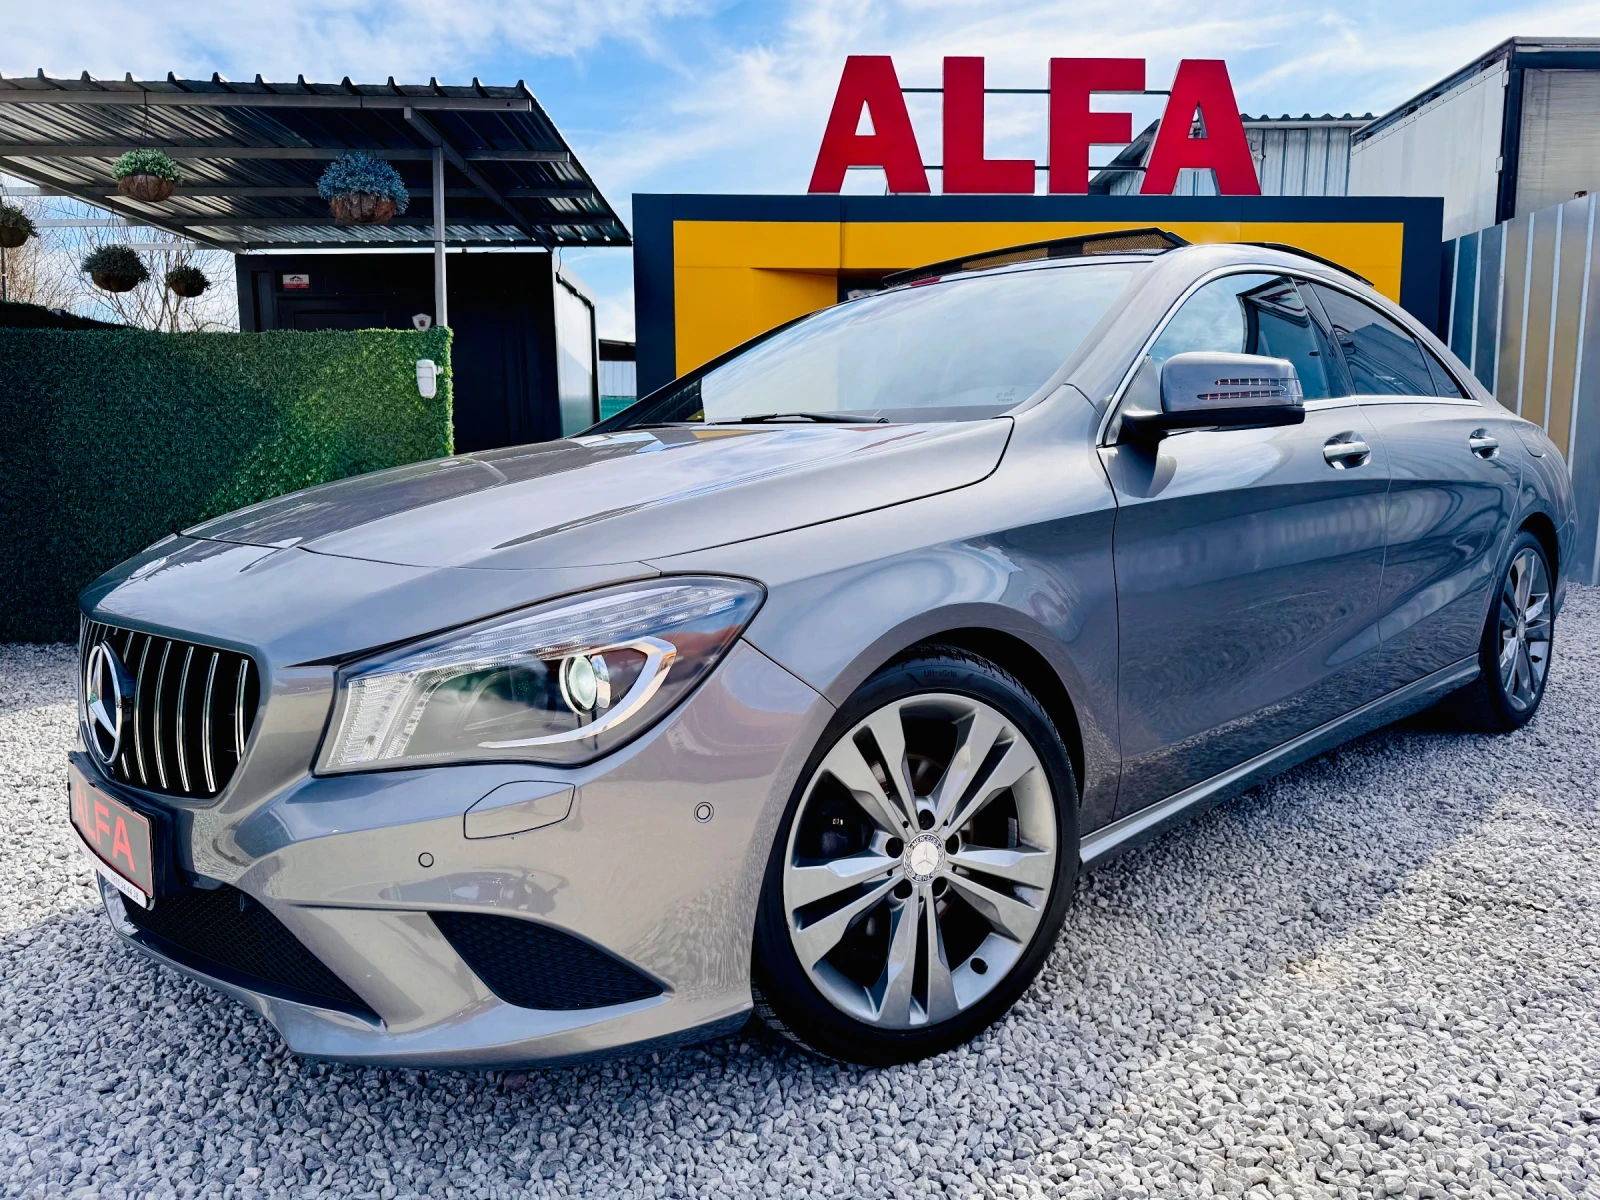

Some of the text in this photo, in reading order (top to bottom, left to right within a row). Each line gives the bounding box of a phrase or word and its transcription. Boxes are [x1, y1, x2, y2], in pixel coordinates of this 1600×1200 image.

[808, 55, 1261, 195] ALFA
[924, 669, 957, 678] UltraGrip
[75, 781, 136, 873] ALFA
[914, 874, 932, 882] BENZ
